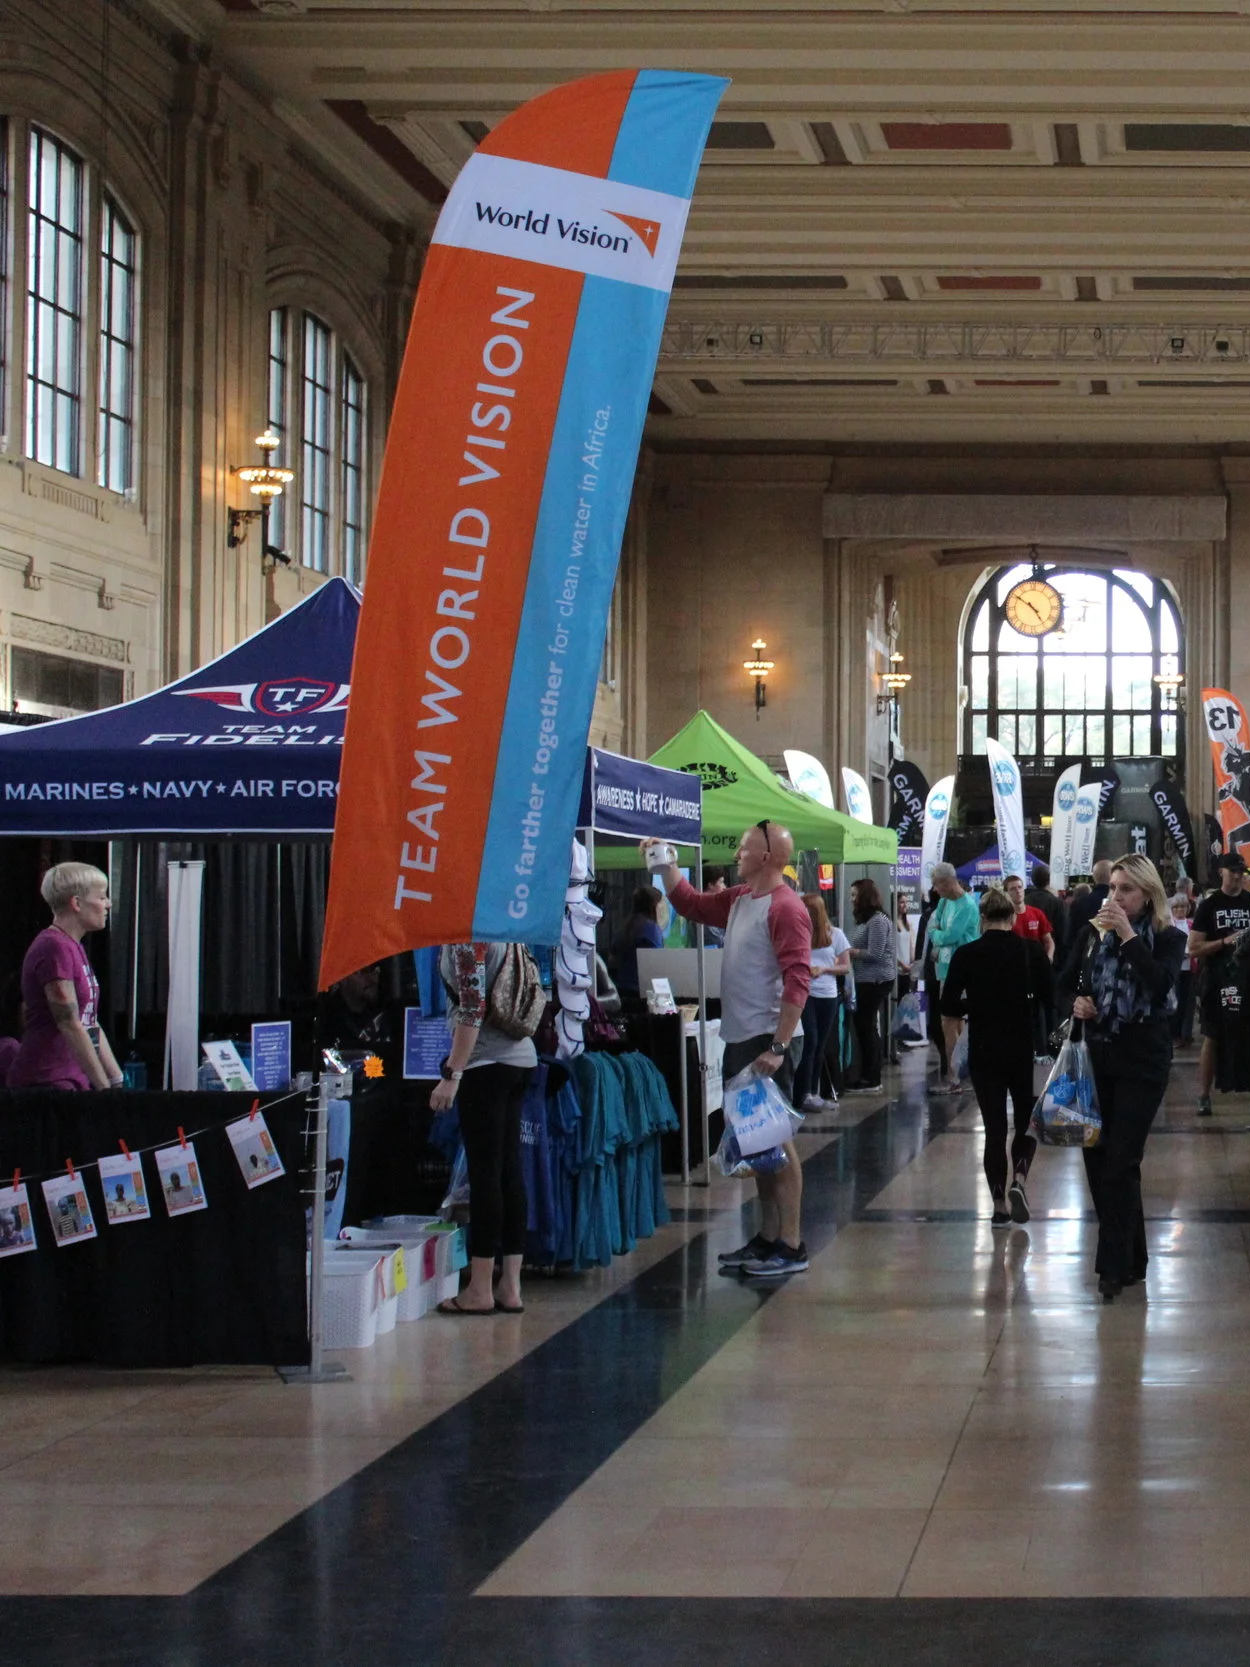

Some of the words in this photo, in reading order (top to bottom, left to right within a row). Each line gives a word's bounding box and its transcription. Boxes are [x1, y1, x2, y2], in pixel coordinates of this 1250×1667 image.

[475, 202, 550, 235] World
[557, 218, 630, 254] Vision
[456, 285, 536, 488] VISION
[580, 404, 611, 472] Africa.
[577, 472, 599, 492] in
[569, 498, 593, 561] water
[554, 564, 582, 618] clean
[417, 507, 491, 729] WORLD
[547, 622, 571, 655] for
[268, 688, 326, 702] TF
[531, 661, 565, 775] together
[222, 725, 317, 734] TEAM
[5, 782, 125, 801] MARINES
[143, 780, 213, 799] NAVY
[230, 780, 275, 798] AIR
[596, 784, 634, 811] AWARENESS
[642, 792, 658, 813] HOPE
[664, 797, 700, 821] CAMARADERIE
[1121, 786, 1150, 794] GARMIN
[394, 749, 452, 911] TEAM
[514, 782, 547, 876] farther
[1153, 791, 1191, 858] GARMIN
[508, 883, 531, 919] Go
[1216, 909, 1250, 919] PUSH
